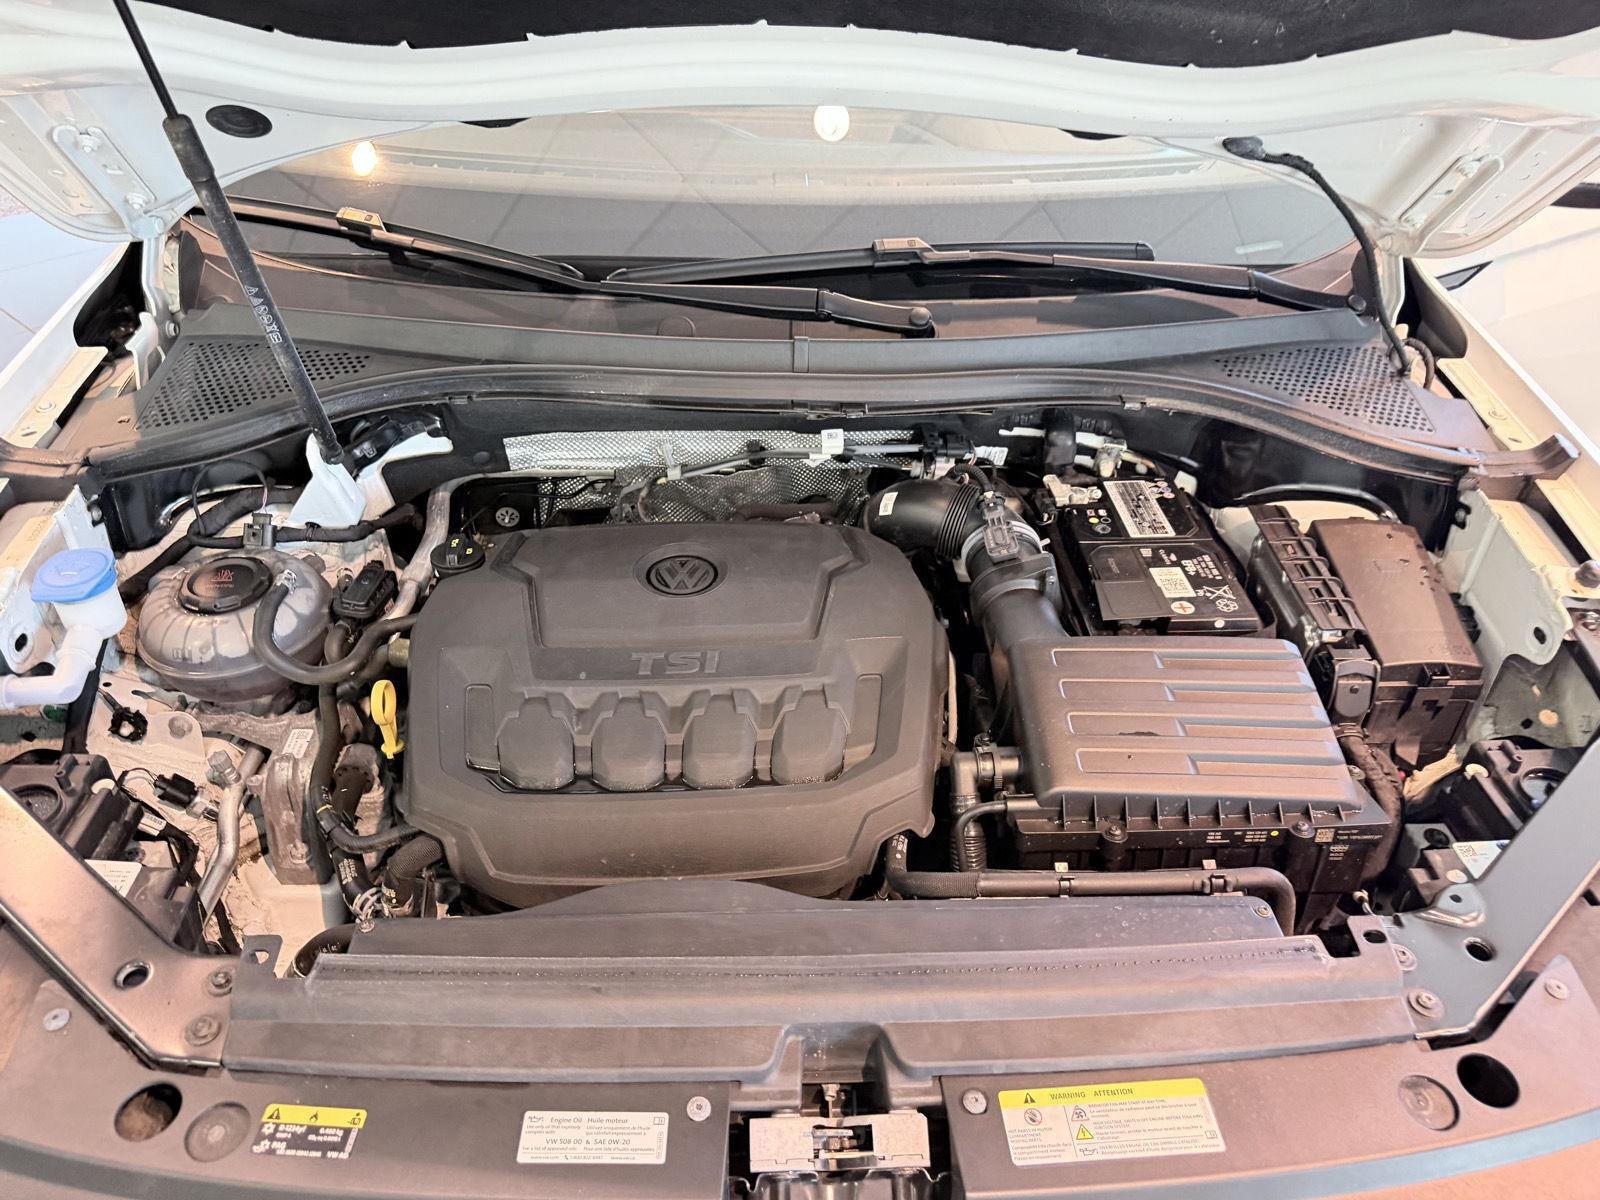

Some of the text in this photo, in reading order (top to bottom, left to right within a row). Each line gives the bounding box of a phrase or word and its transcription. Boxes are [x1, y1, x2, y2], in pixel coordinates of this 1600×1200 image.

[630, 650, 721, 675] TSI
[1050, 1088, 1134, 1100] WARNING ATTENTION
[550, 1116, 572, 1125] Engine
